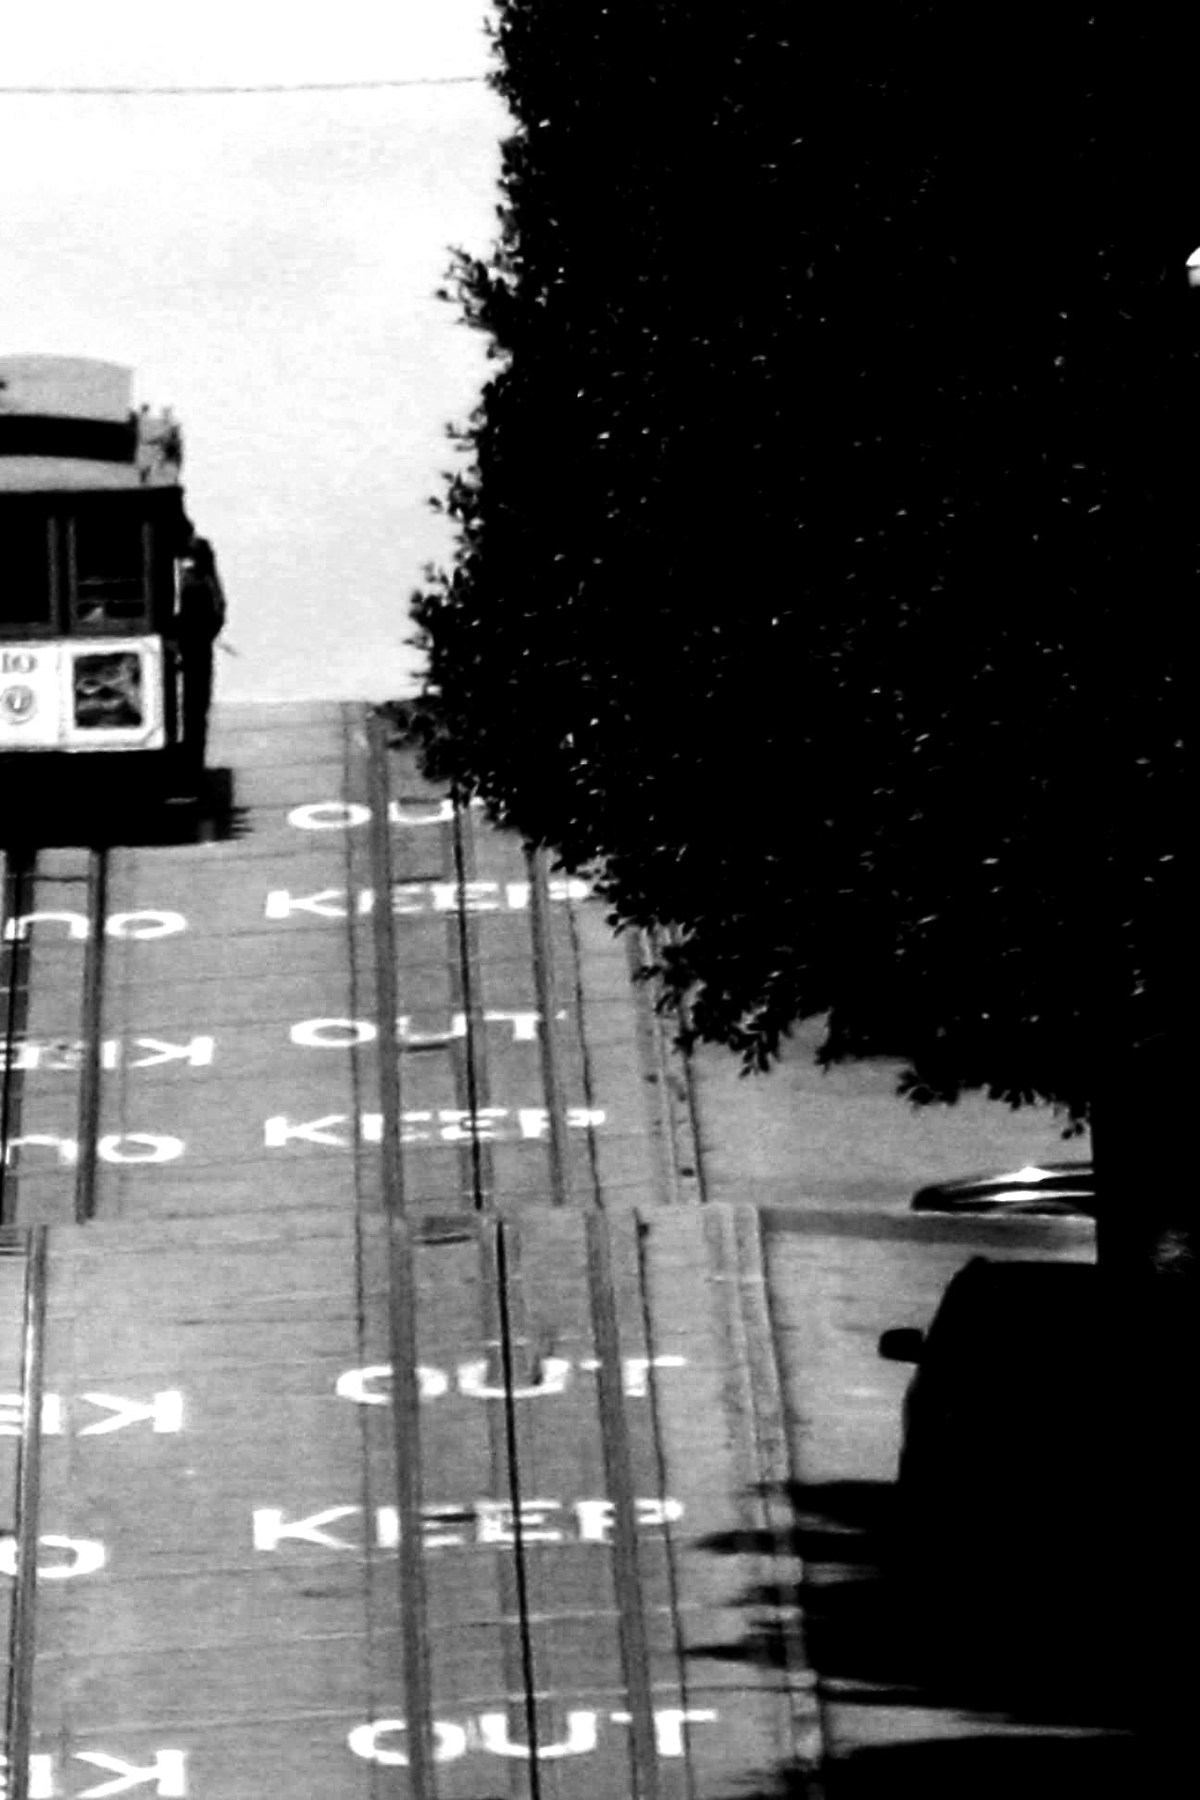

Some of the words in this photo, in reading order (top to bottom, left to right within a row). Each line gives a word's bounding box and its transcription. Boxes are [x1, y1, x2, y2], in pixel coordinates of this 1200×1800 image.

[287, 796, 484, 830] OU
[265, 880, 590, 919] KEEP
[289, 1008, 568, 1048] OUT
[264, 1107, 606, 1147] KEEP
[335, 1355, 688, 1405] OUT
[252, 1499, 684, 1551] KEEP
[347, 1710, 719, 1767] OUT
